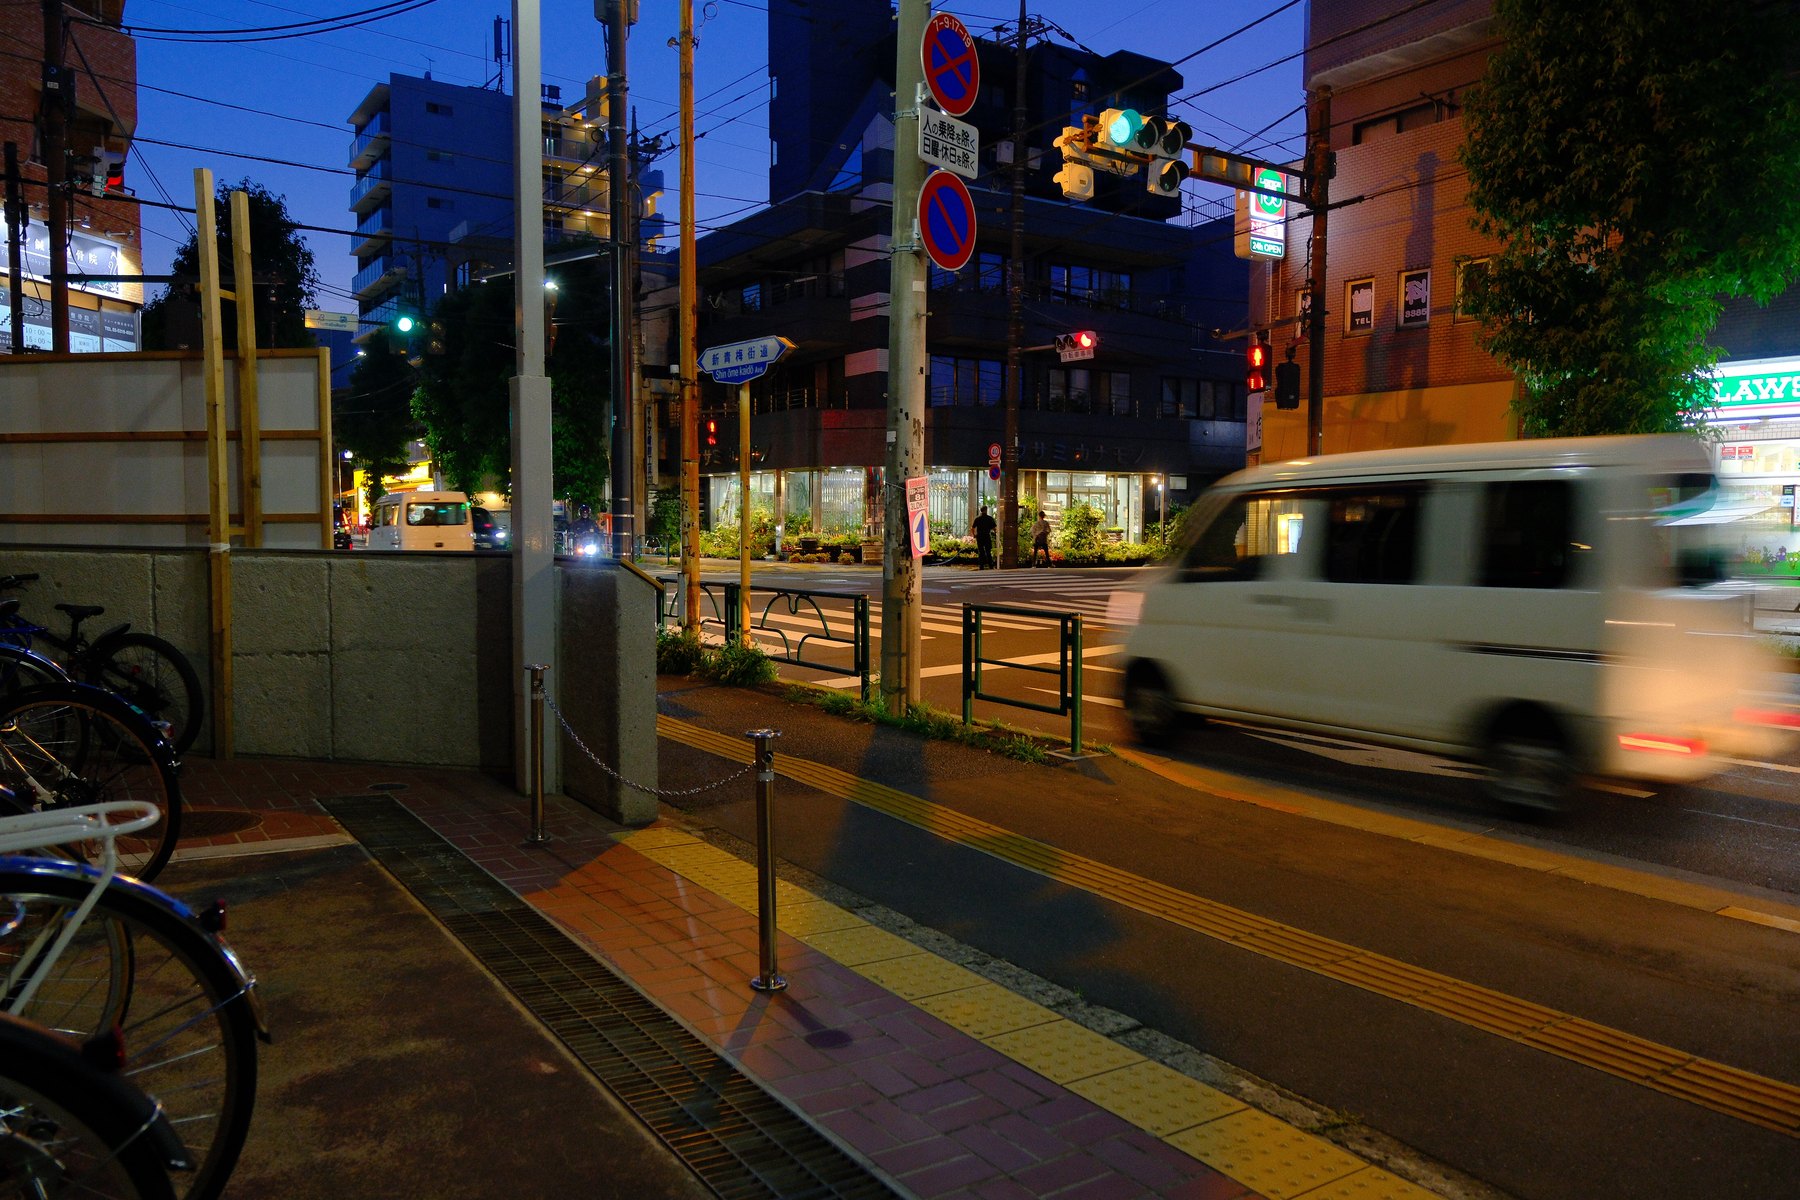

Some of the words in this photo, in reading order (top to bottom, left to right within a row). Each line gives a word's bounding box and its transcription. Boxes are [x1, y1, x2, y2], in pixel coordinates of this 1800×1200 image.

[923, 114, 976, 150] 人の乗降を除く
[1264, 243, 1282, 255] OPEN
[1355, 316, 1371, 326] TEL
[712, 344, 768, 366] 新青梅街道
[715, 369, 726, 380] Shin
